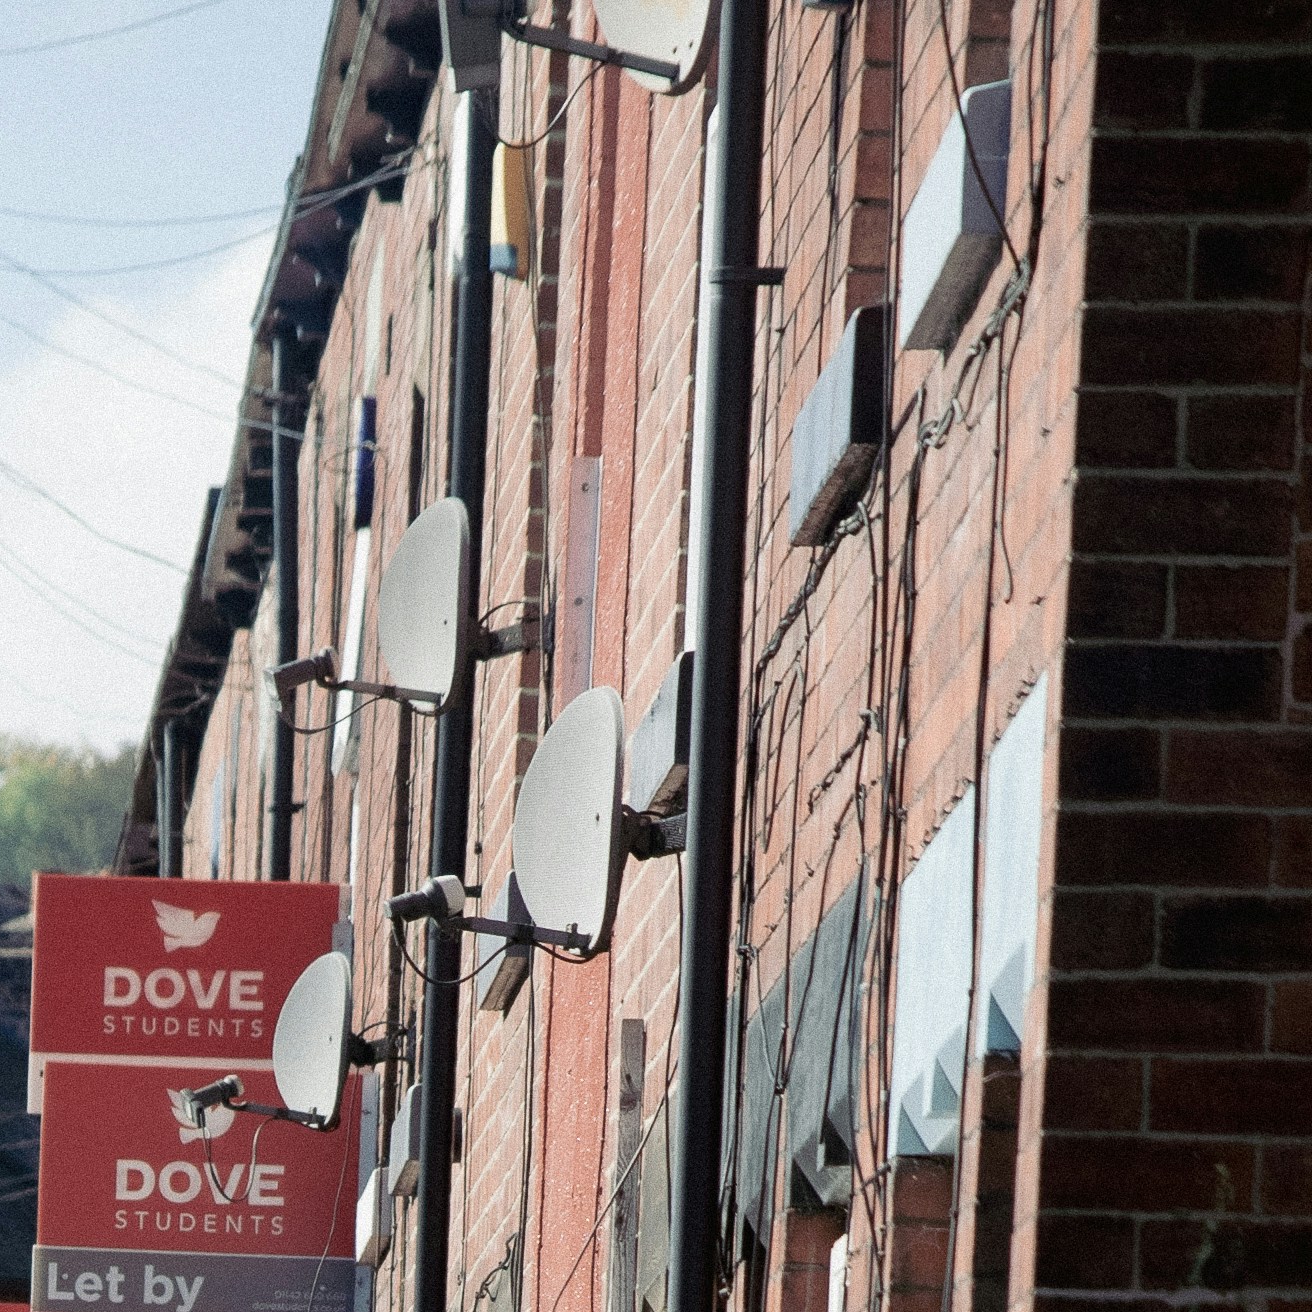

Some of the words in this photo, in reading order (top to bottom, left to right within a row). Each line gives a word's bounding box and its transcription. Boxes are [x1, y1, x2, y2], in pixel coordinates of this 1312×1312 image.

[102, 966, 265, 1011] DOVE
[102, 1015, 264, 1037] STUDENTS
[115, 1159, 286, 1207] DOVE
[114, 1210, 284, 1236] STUDENTS
[46, 1261, 125, 1303] Let
